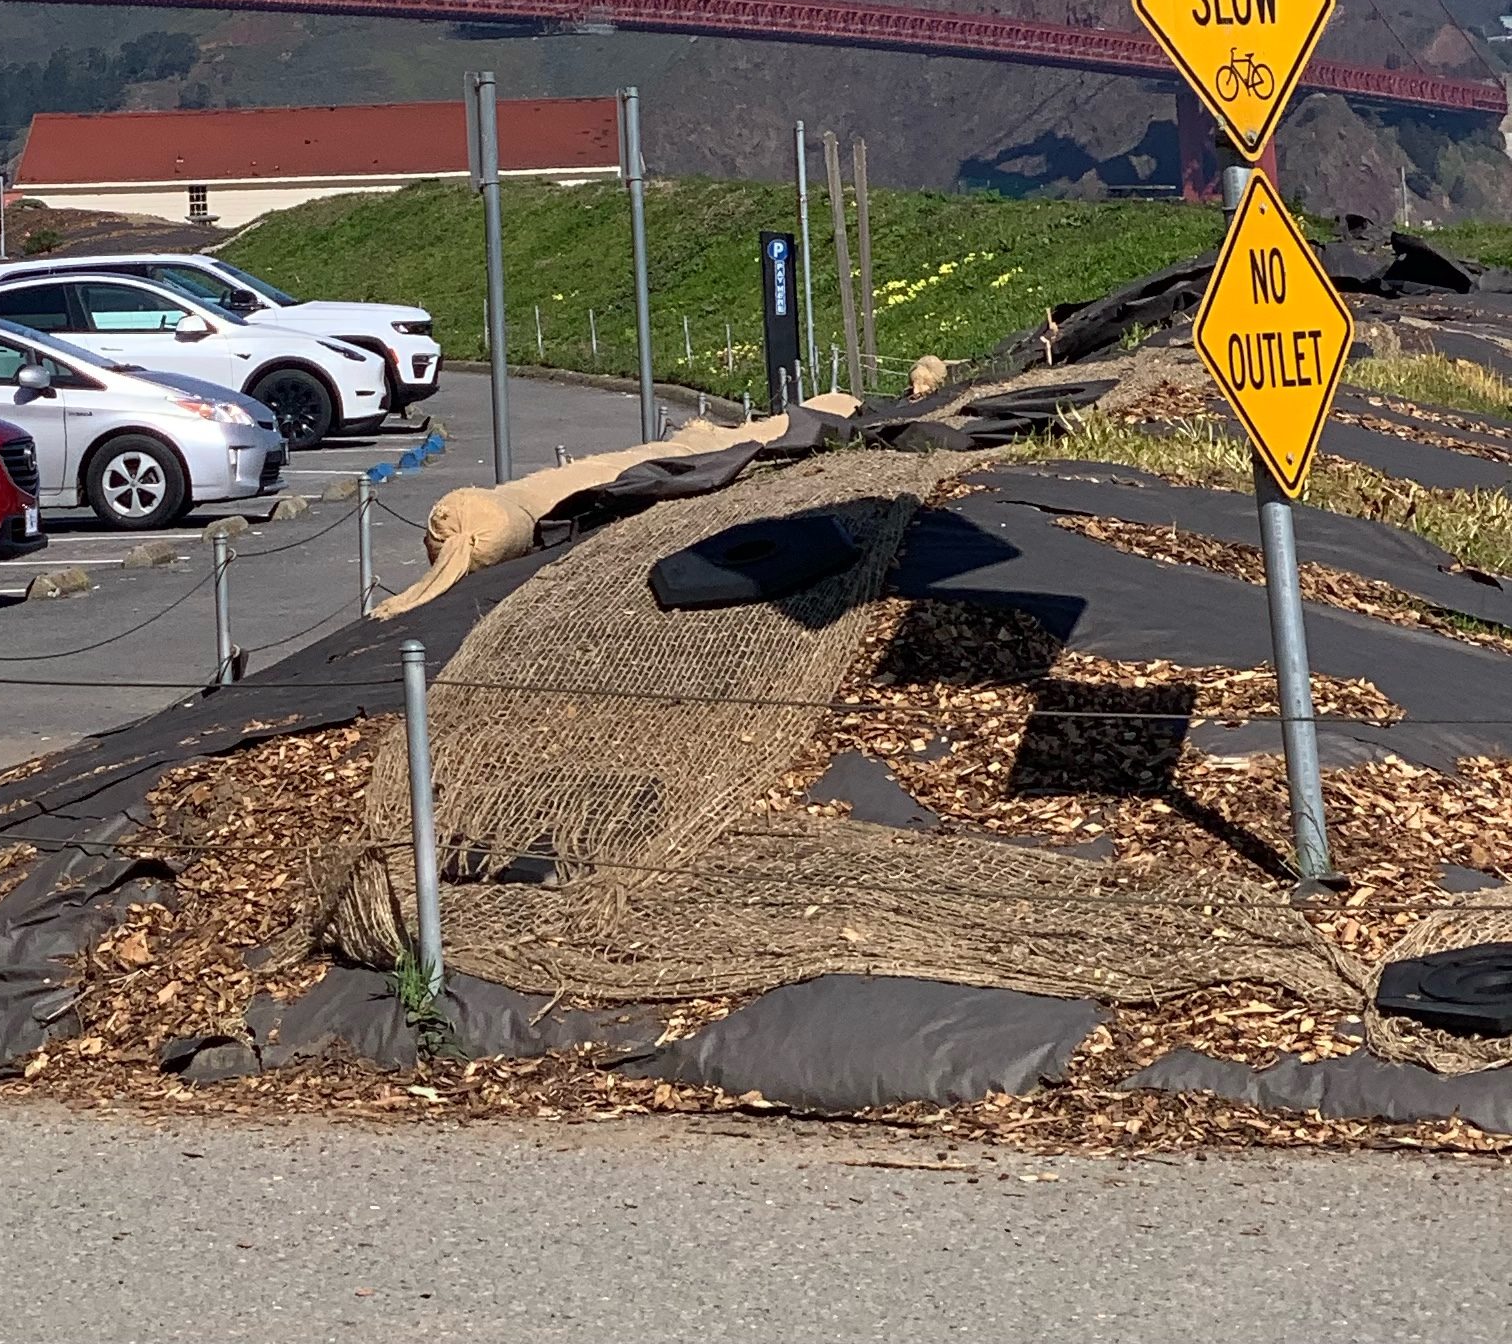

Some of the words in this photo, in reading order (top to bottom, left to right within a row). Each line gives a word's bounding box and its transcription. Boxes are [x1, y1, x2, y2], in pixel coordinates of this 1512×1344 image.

[774, 242, 784, 258] P
[1249, 248, 1286, 305] NO
[1228, 330, 1323, 392] OUTLET
